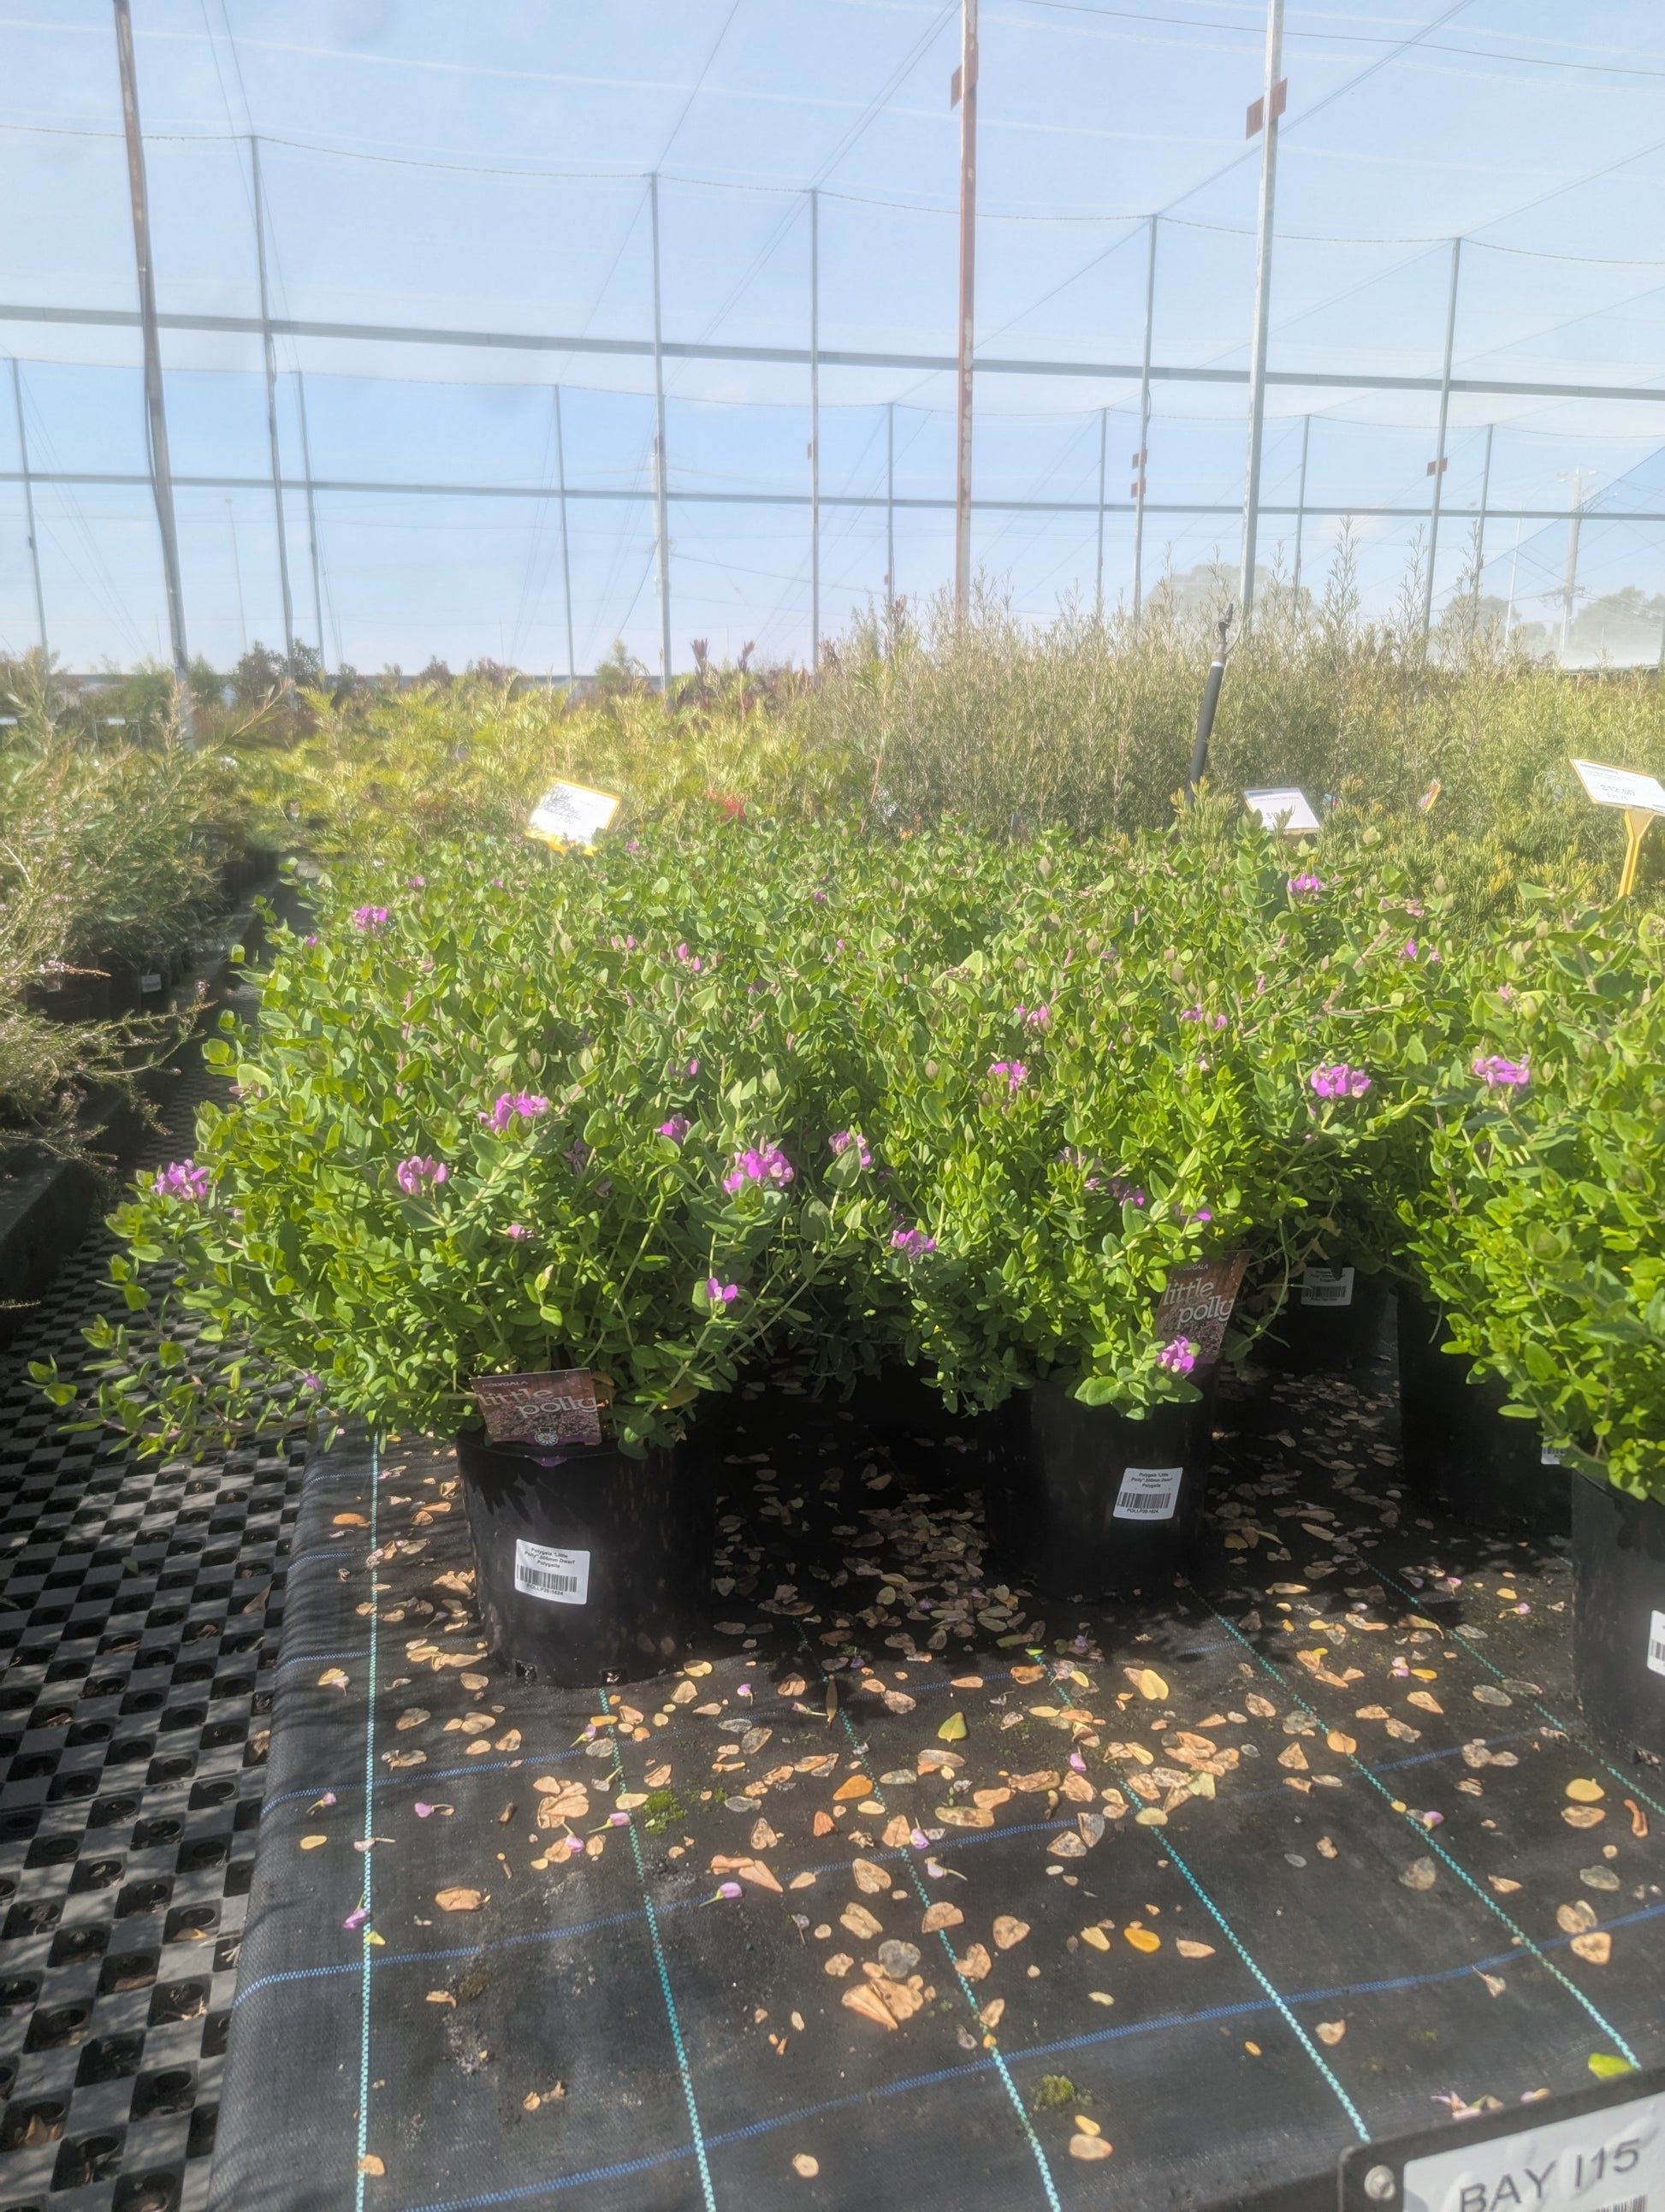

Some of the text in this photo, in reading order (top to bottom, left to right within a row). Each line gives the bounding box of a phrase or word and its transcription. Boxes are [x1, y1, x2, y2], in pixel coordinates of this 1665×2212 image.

[1164, 1278, 1214, 1306] little
[1177, 1295, 1235, 1330] polly
[476, 1389, 554, 1407] little
[517, 1397, 597, 1419] polly
[1460, 2160, 1558, 2212] BAY
